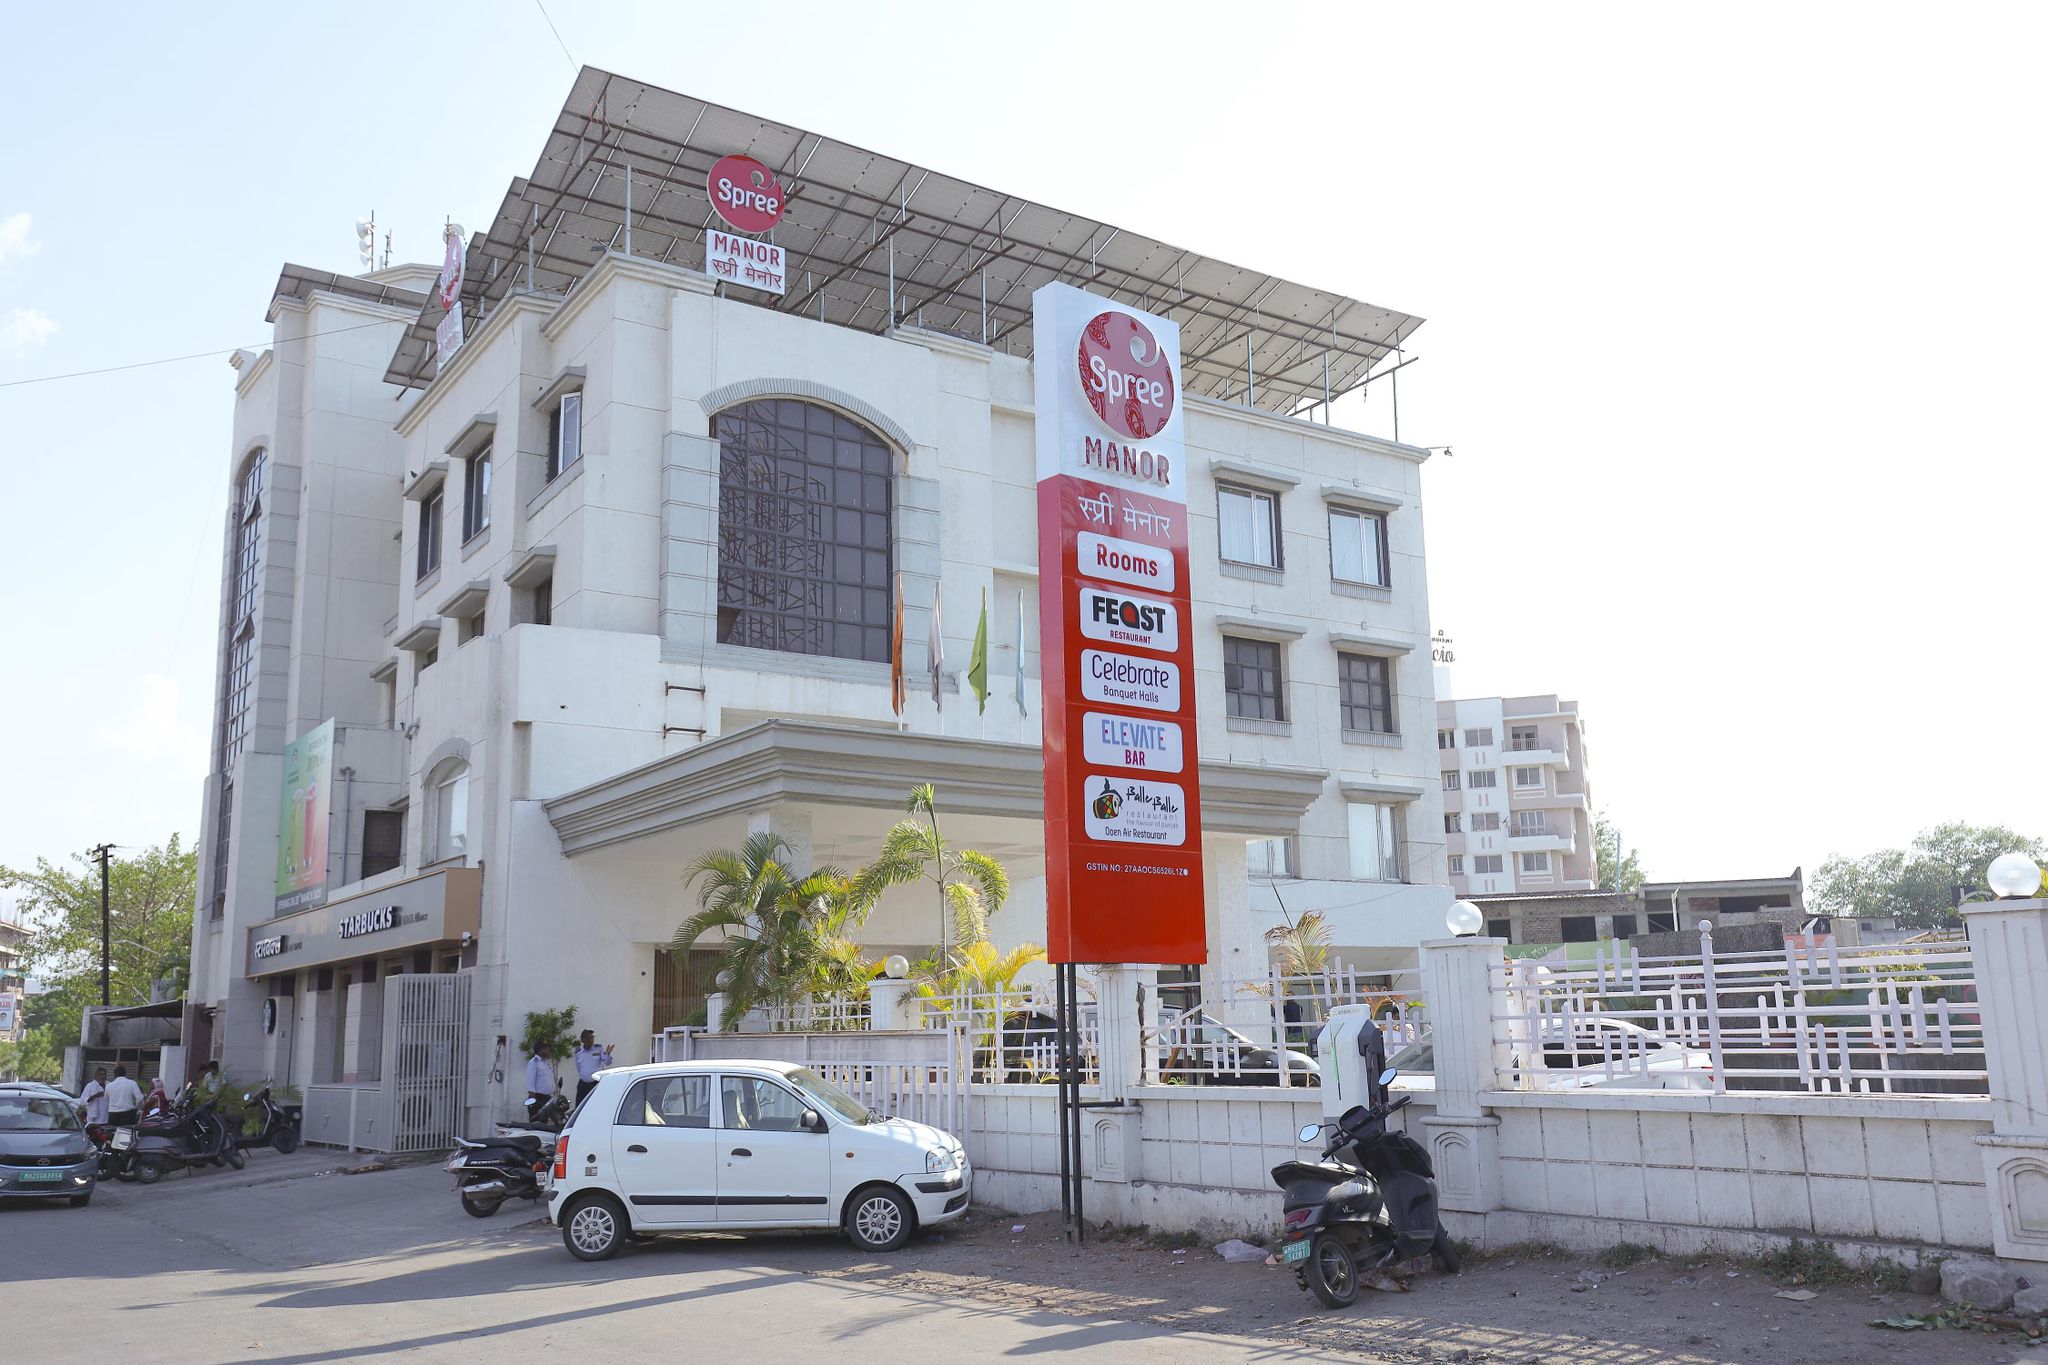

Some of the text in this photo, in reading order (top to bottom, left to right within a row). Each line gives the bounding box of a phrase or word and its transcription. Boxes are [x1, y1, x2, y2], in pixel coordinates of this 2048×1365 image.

[717, 177, 779, 216] Spree
[714, 233, 780, 266] MANOR
[712, 258, 783, 288] स्प्री मेनोर
[1089, 355, 1164, 408] Spree
[1085, 436, 1170, 486] MANOR
[1078, 492, 1171, 538] स्प्री मेनोर
[1097, 543, 1158, 577] Rooms
[1110, 630, 1151, 644] RESTAURANT
[1092, 654, 1169, 689] Celebrate
[1103, 685, 1159, 703] Banquet Halls
[1101, 719, 1166, 751] ELEVATE
[1125, 749, 1145, 766] BAR
[1105, 826, 1168, 840] Open Air Restaurant
[1086, 862, 1108, 871] GSTIN
[339, 906, 392, 938] STARBUCKS
